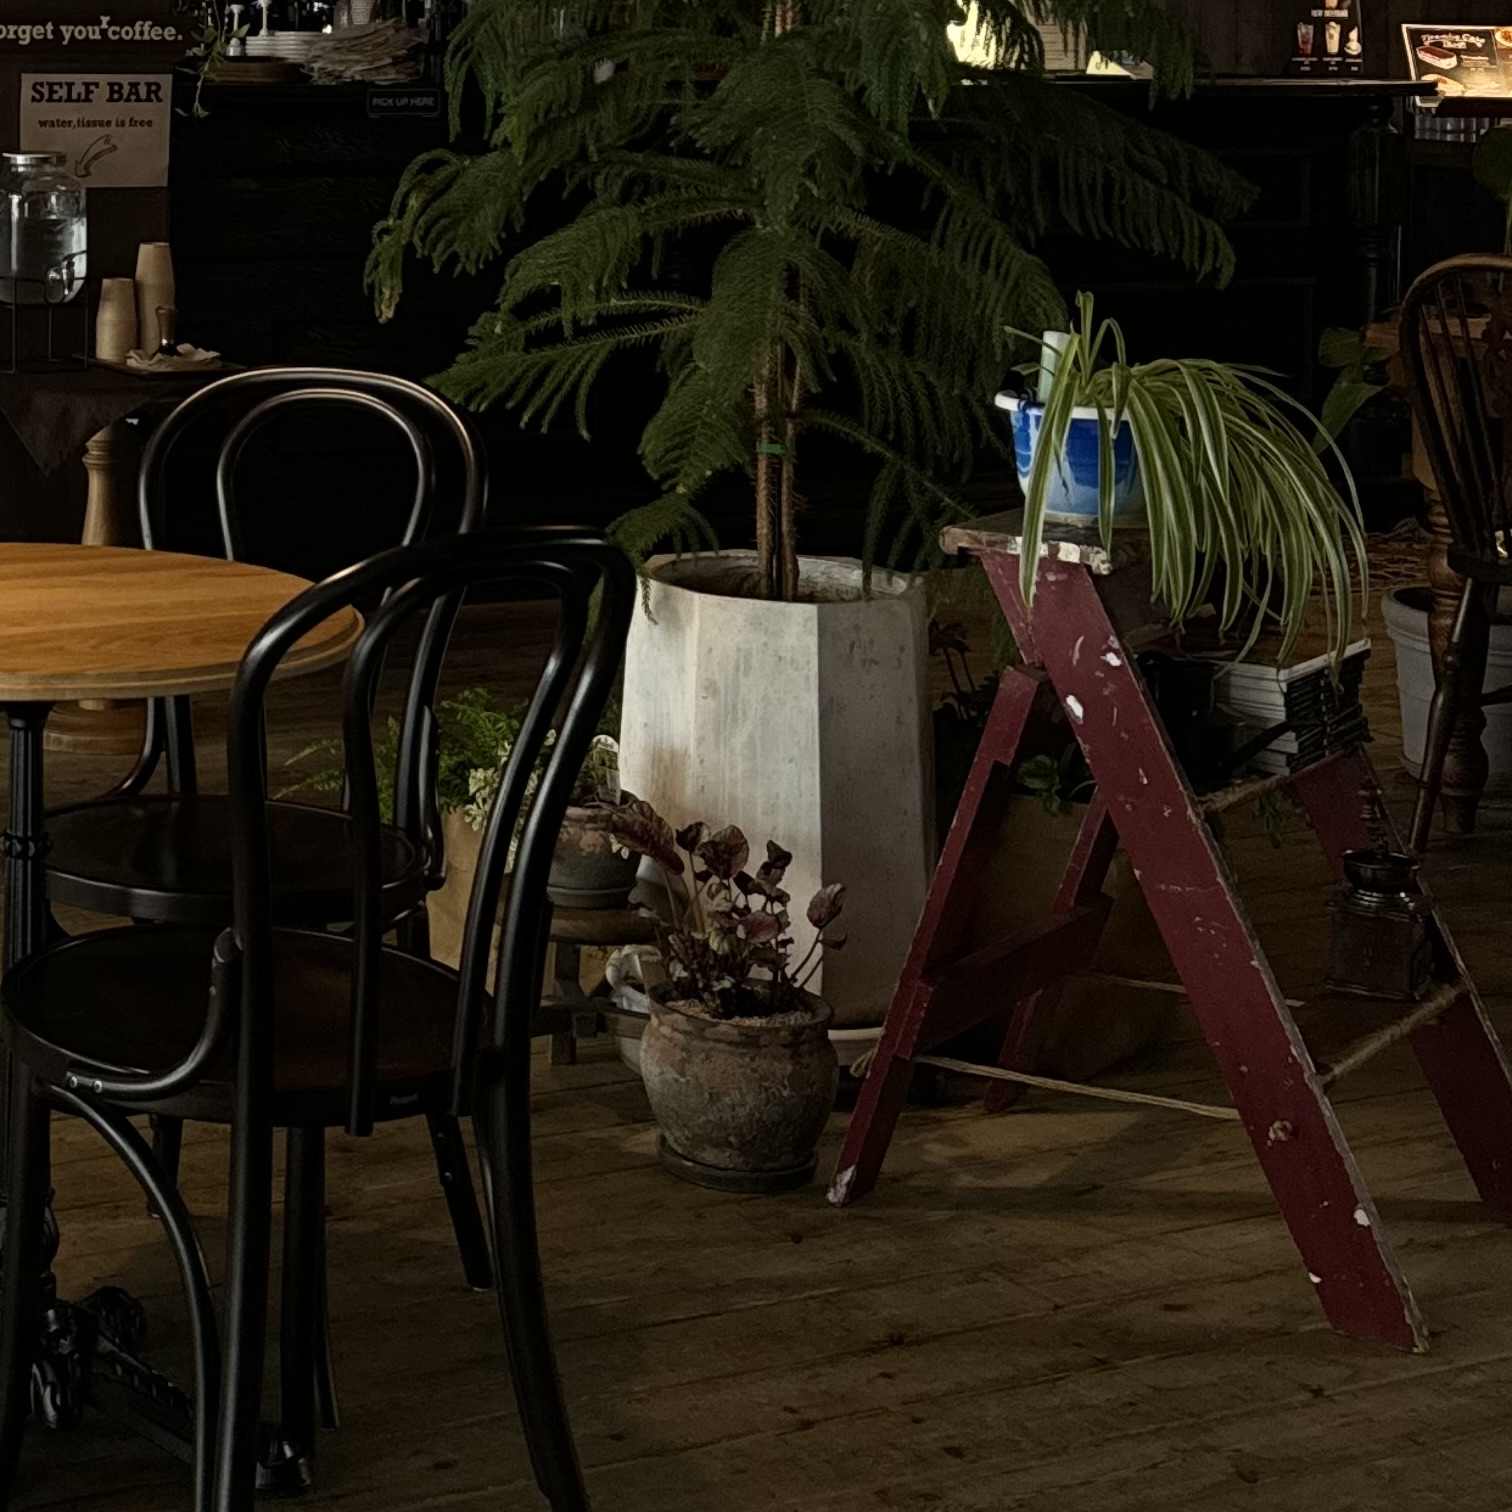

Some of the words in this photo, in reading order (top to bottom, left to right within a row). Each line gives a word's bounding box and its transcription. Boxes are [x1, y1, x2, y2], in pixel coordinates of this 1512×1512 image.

[59, 15, 111, 46] your
[107, 20, 184, 41] coffee.
[31, 81, 100, 103] SELF
[106, 81, 164, 103] BAR
[115, 116, 126, 128] is
[128, 116, 153, 128] free
